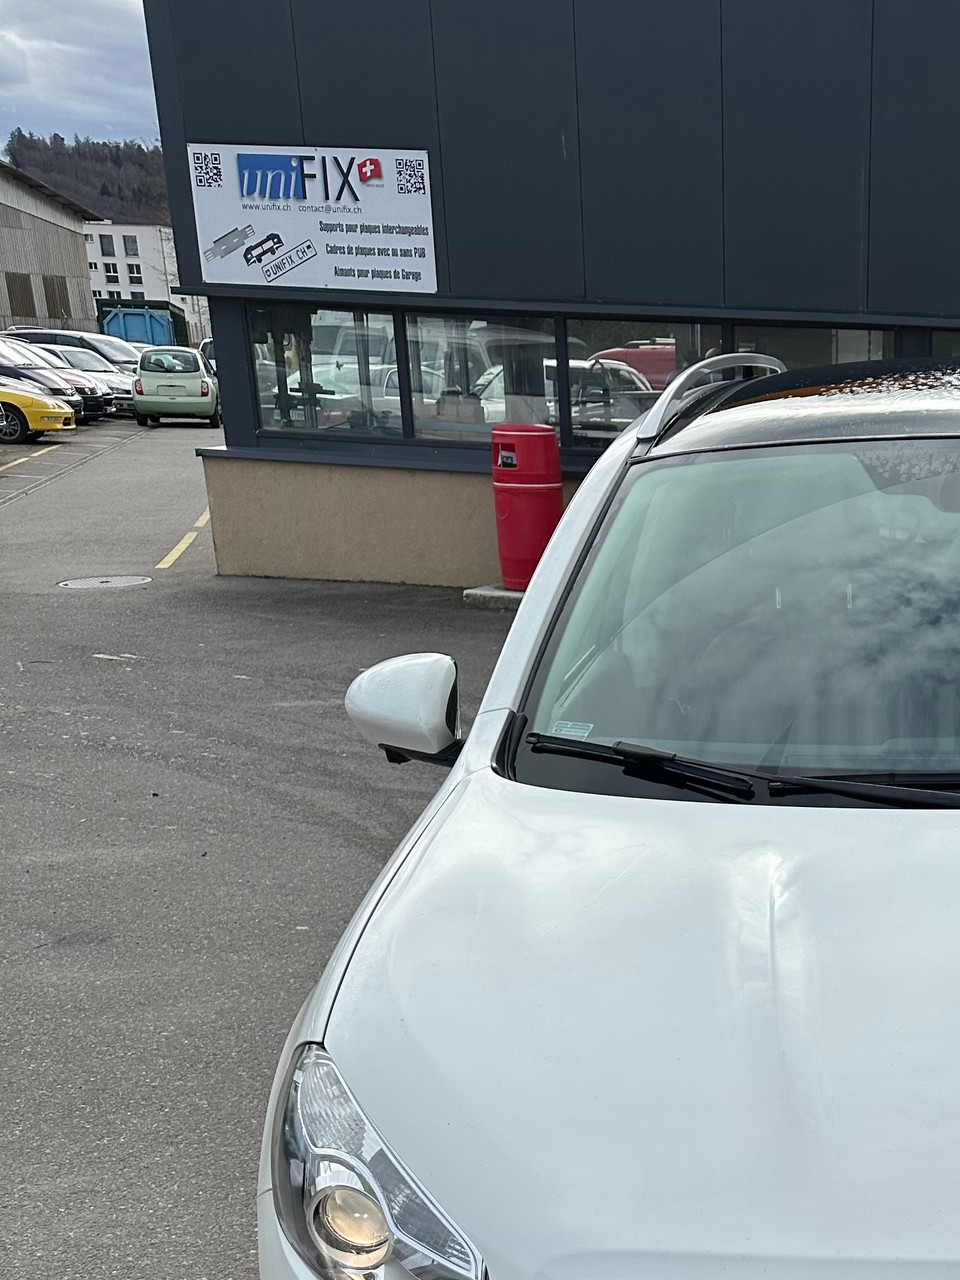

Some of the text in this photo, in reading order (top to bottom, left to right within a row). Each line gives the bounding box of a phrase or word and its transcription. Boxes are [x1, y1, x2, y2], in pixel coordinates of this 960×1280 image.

[241, 203, 362, 214] www.unifix.ch contact@unifix.ch
[319, 220, 429, 236] Supports pour plaques interchangeables
[326, 243, 346, 255] Cadres
[347, 245, 353, 255] de
[355, 245, 376, 257] plaques
[377, 247, 390, 256] avec
[399, 247, 413, 257] sans
[414, 247, 426, 258] PUB
[334, 266, 421, 282] Aimants pour plaques de Garage
